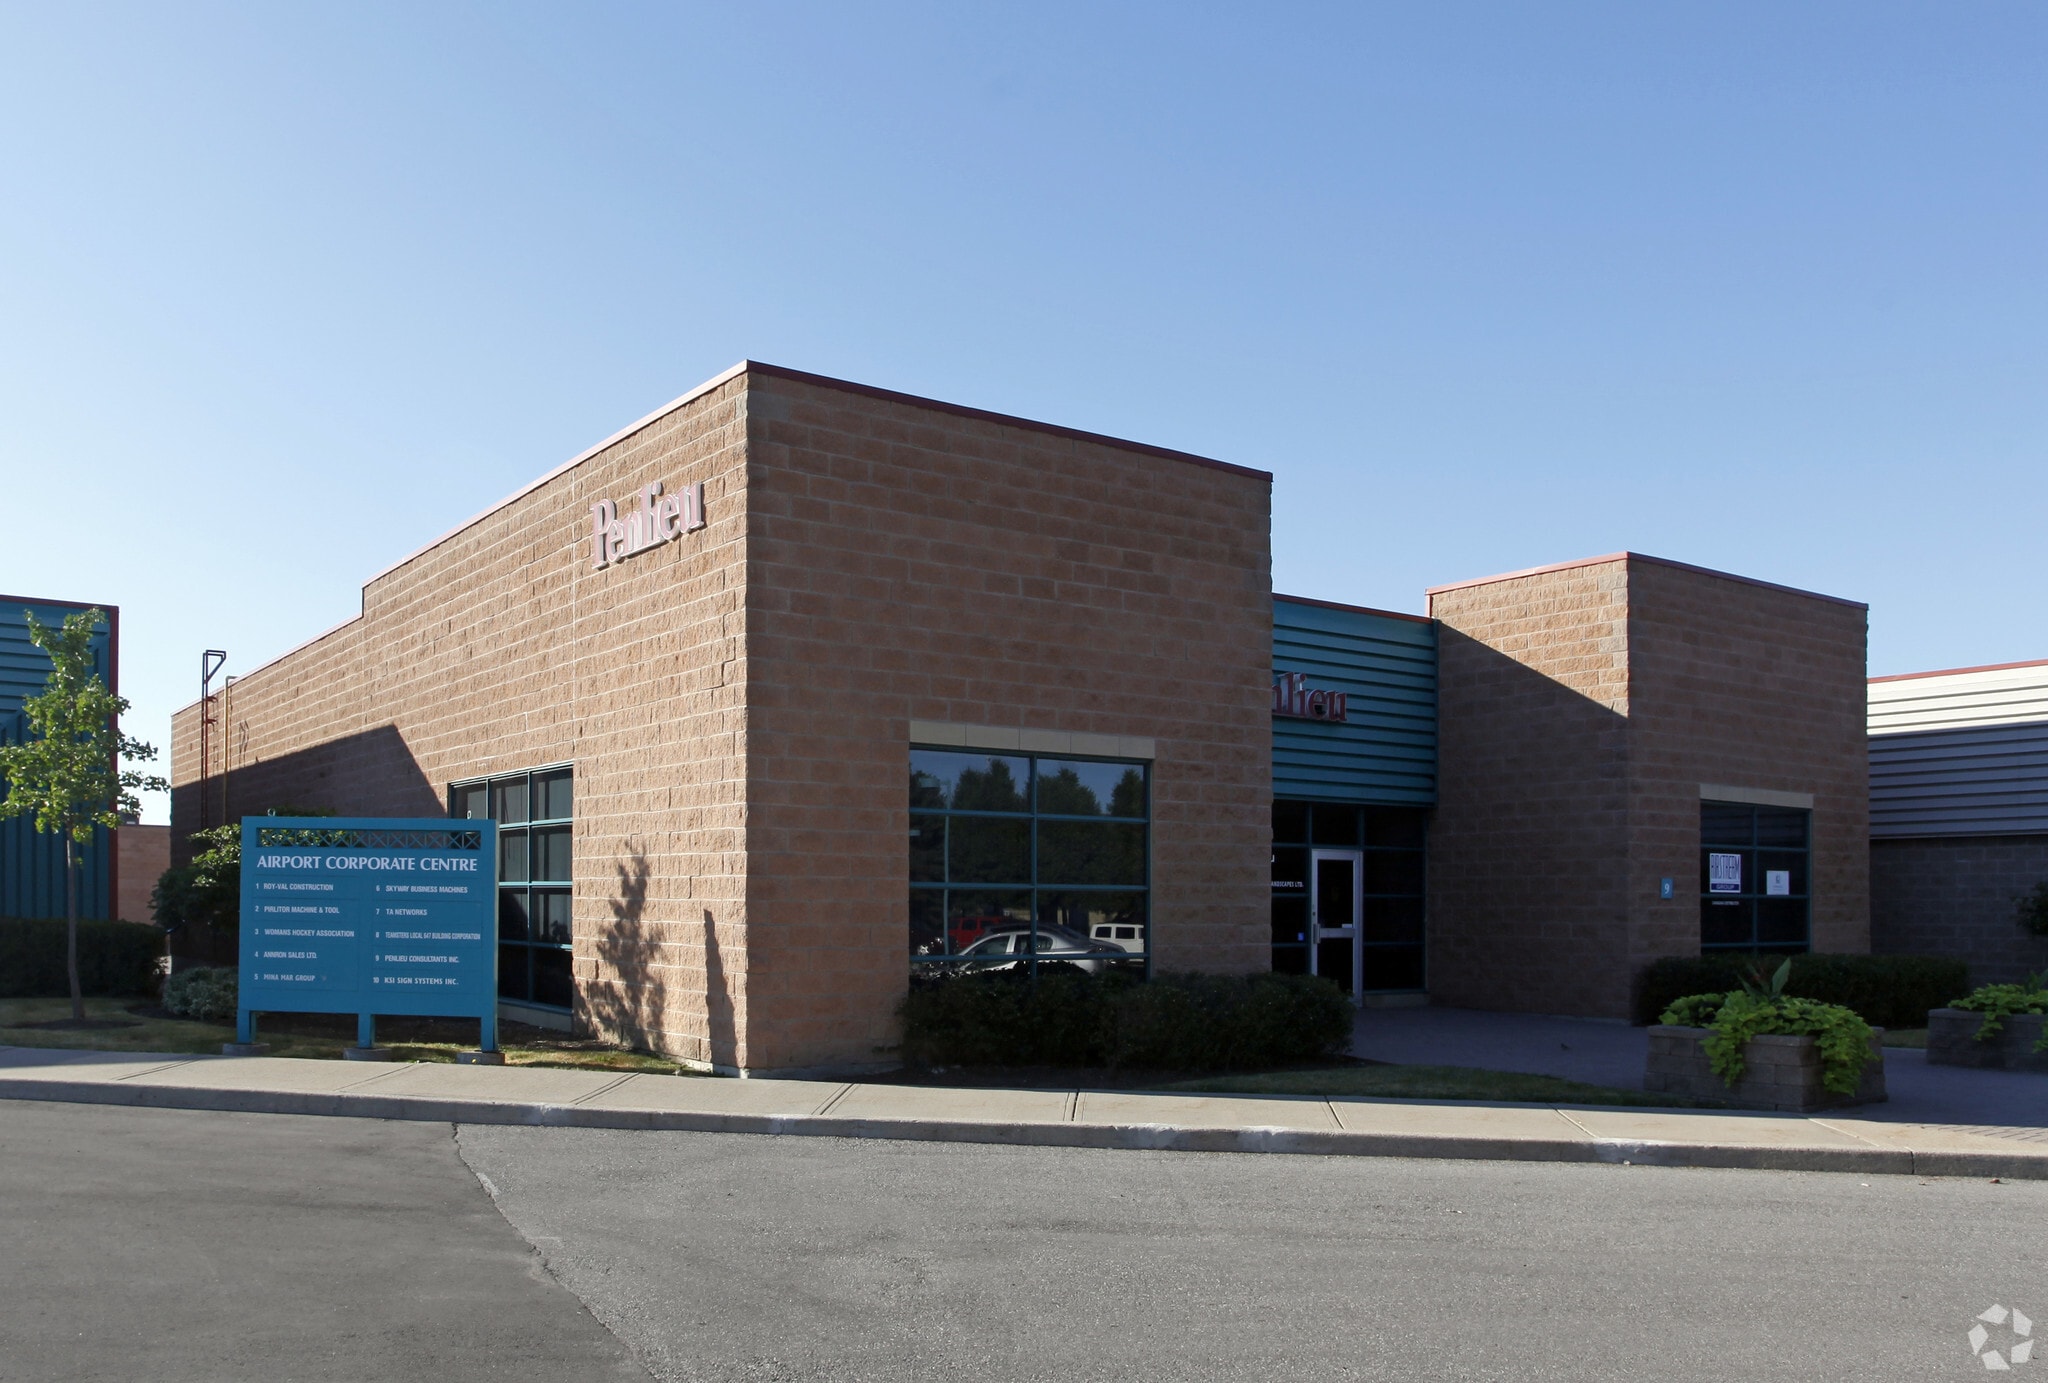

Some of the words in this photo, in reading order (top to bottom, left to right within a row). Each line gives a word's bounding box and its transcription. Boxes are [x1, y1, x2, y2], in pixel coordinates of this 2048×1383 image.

[590, 481, 704, 569] Penlieu
[1272, 672, 1347, 722] nlieu
[257, 855, 321, 869] AIRPORT
[325, 856, 415, 870] CORPORATE
[420, 857, 478, 871] CENTRE
[263, 883, 288, 891] ROY-VAL
[385, 885, 410, 893] SKYWAY
[439, 886, 468, 894] MACHINES
[1664, 883, 1670, 895] 9
[291, 906, 317, 914] MACHINE
[395, 908, 428, 916] NETWORKS
[264, 928, 291, 936] WOMANS
[292, 929, 315, 937] HOCKEY
[385, 931, 409, 939] TEAMSTERS
[432, 932, 451, 940] BUILDING
[384, 954, 408, 962] PENLIEU
[409, 955, 447, 963] CONSULTANTS
[414, 977, 442, 985] SYSTEMS
